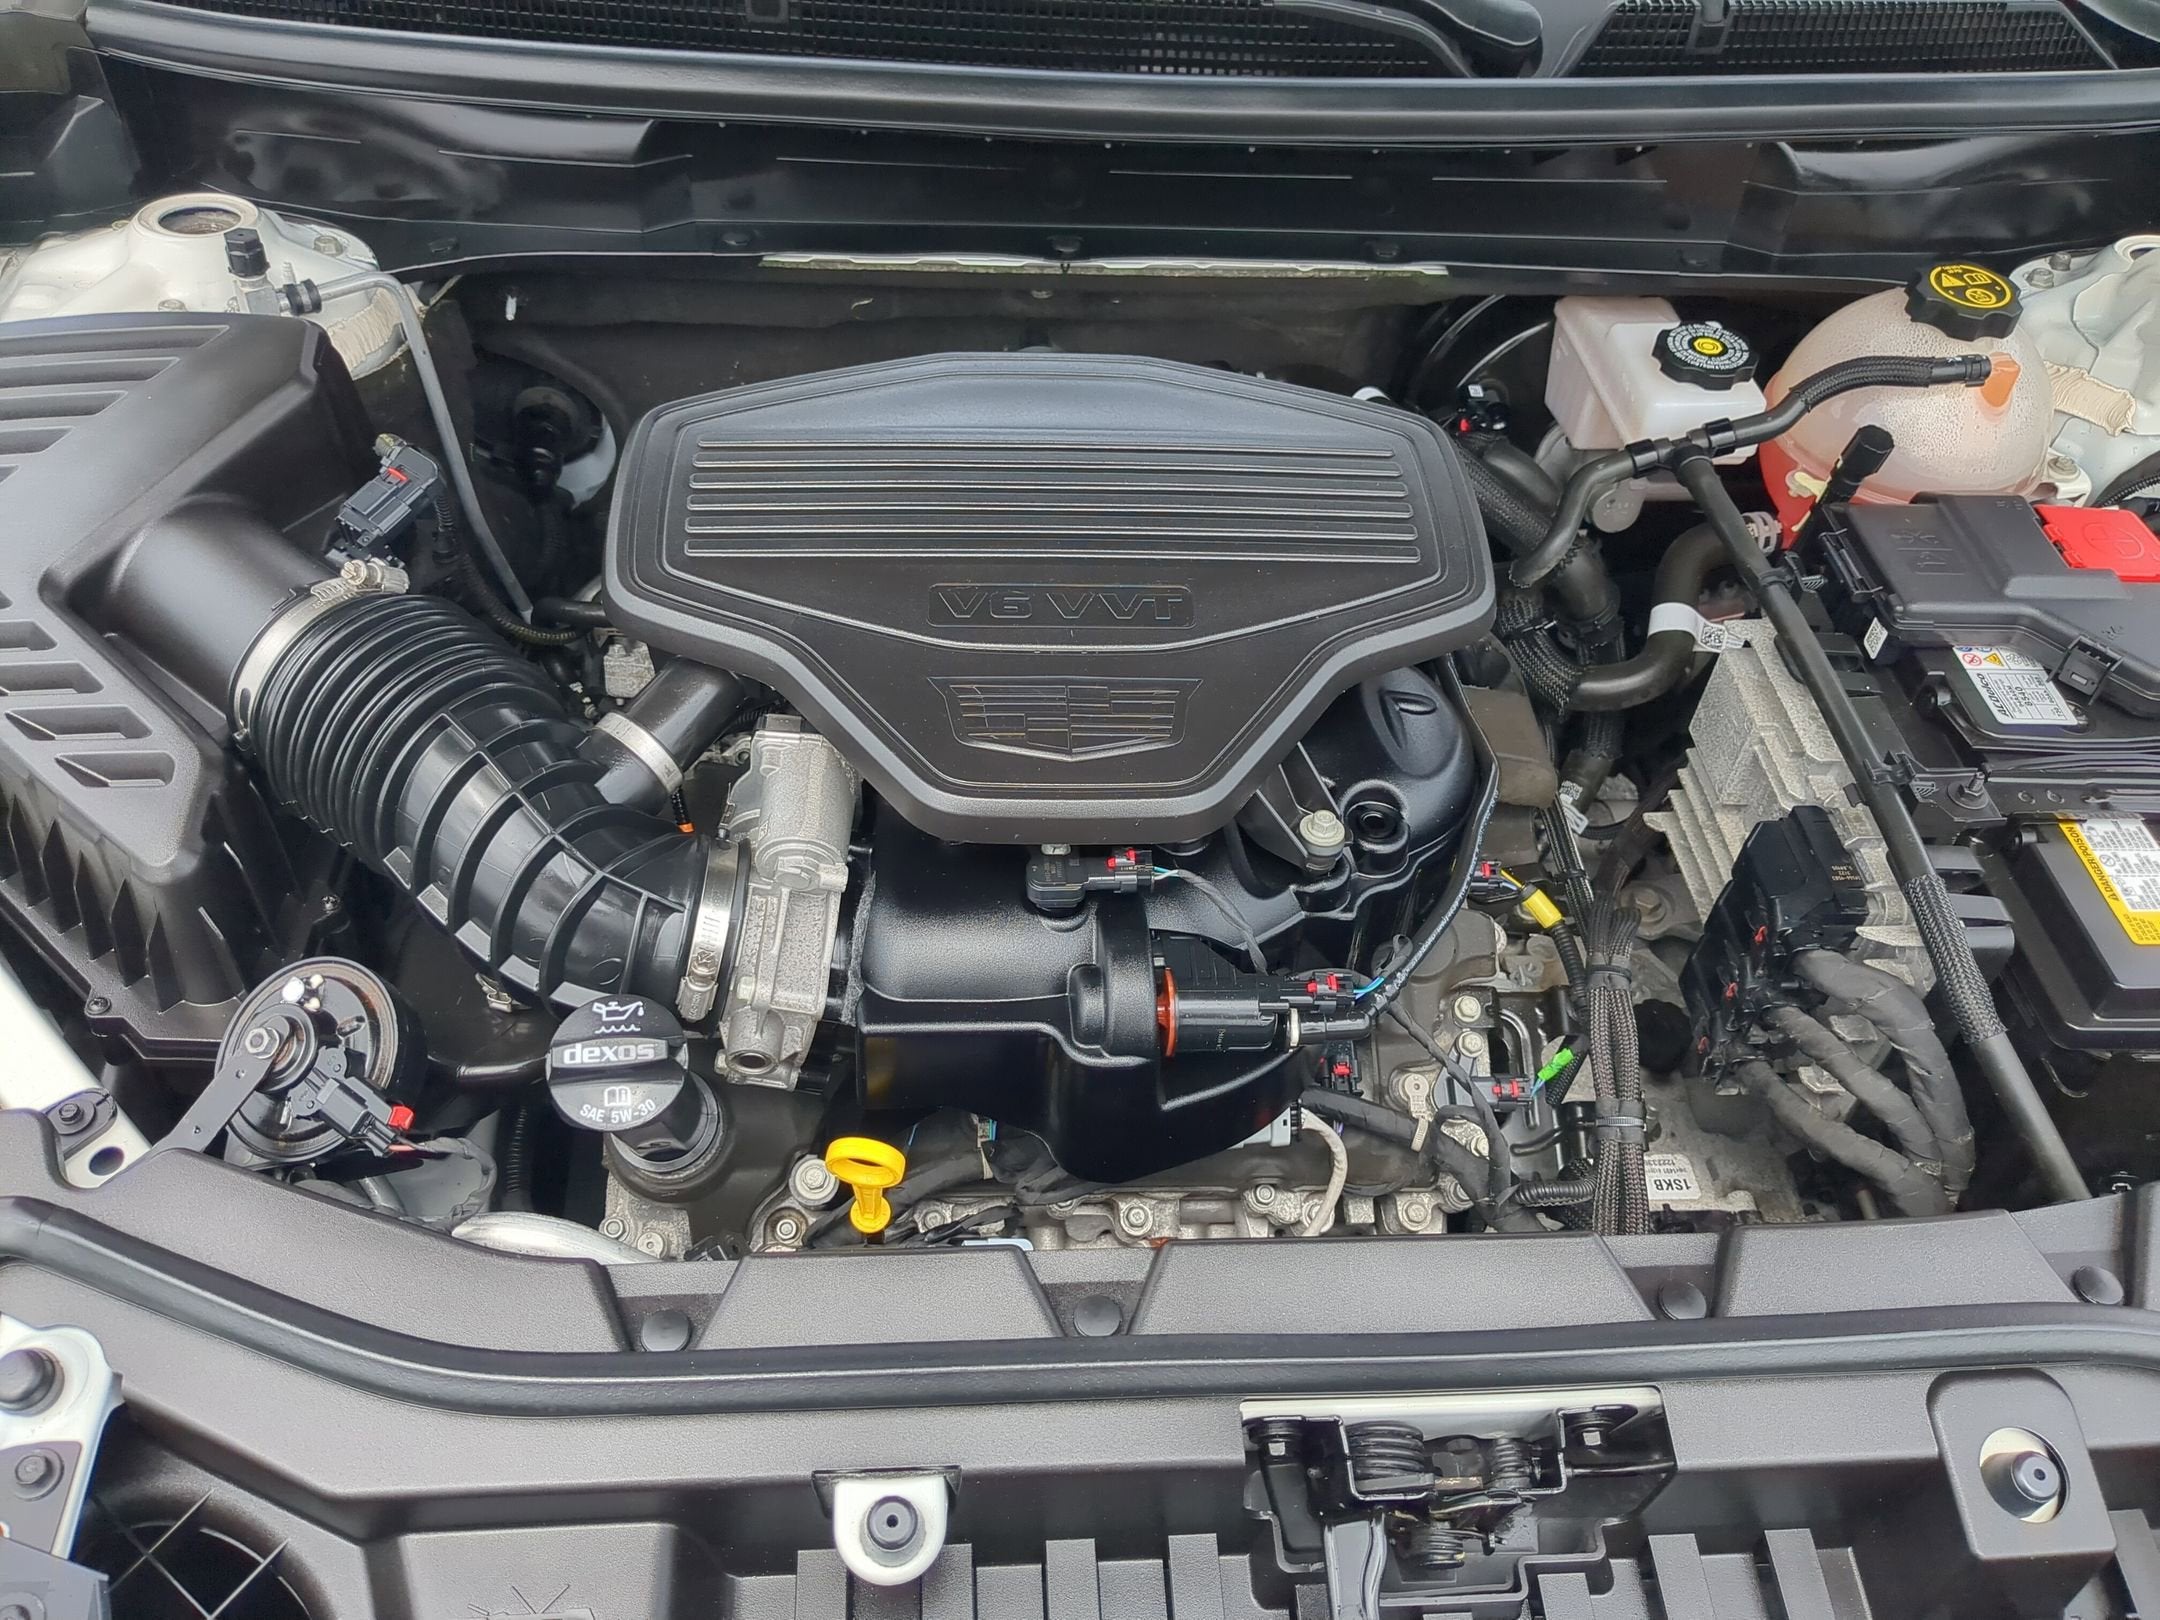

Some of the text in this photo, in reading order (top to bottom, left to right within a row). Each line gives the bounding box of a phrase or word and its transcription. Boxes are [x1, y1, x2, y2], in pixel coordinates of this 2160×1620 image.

[938, 591, 1183, 620] V6 VVT
[1976, 672, 2010, 718] ACDelco
[2014, 686, 2033, 707] 8540
[2065, 826, 2116, 892] DANGER/POISON
[563, 1043, 656, 1065] dexos
[580, 1098, 656, 1124] SAE 5W-30
[1653, 1178, 1692, 1191] 1SKB
